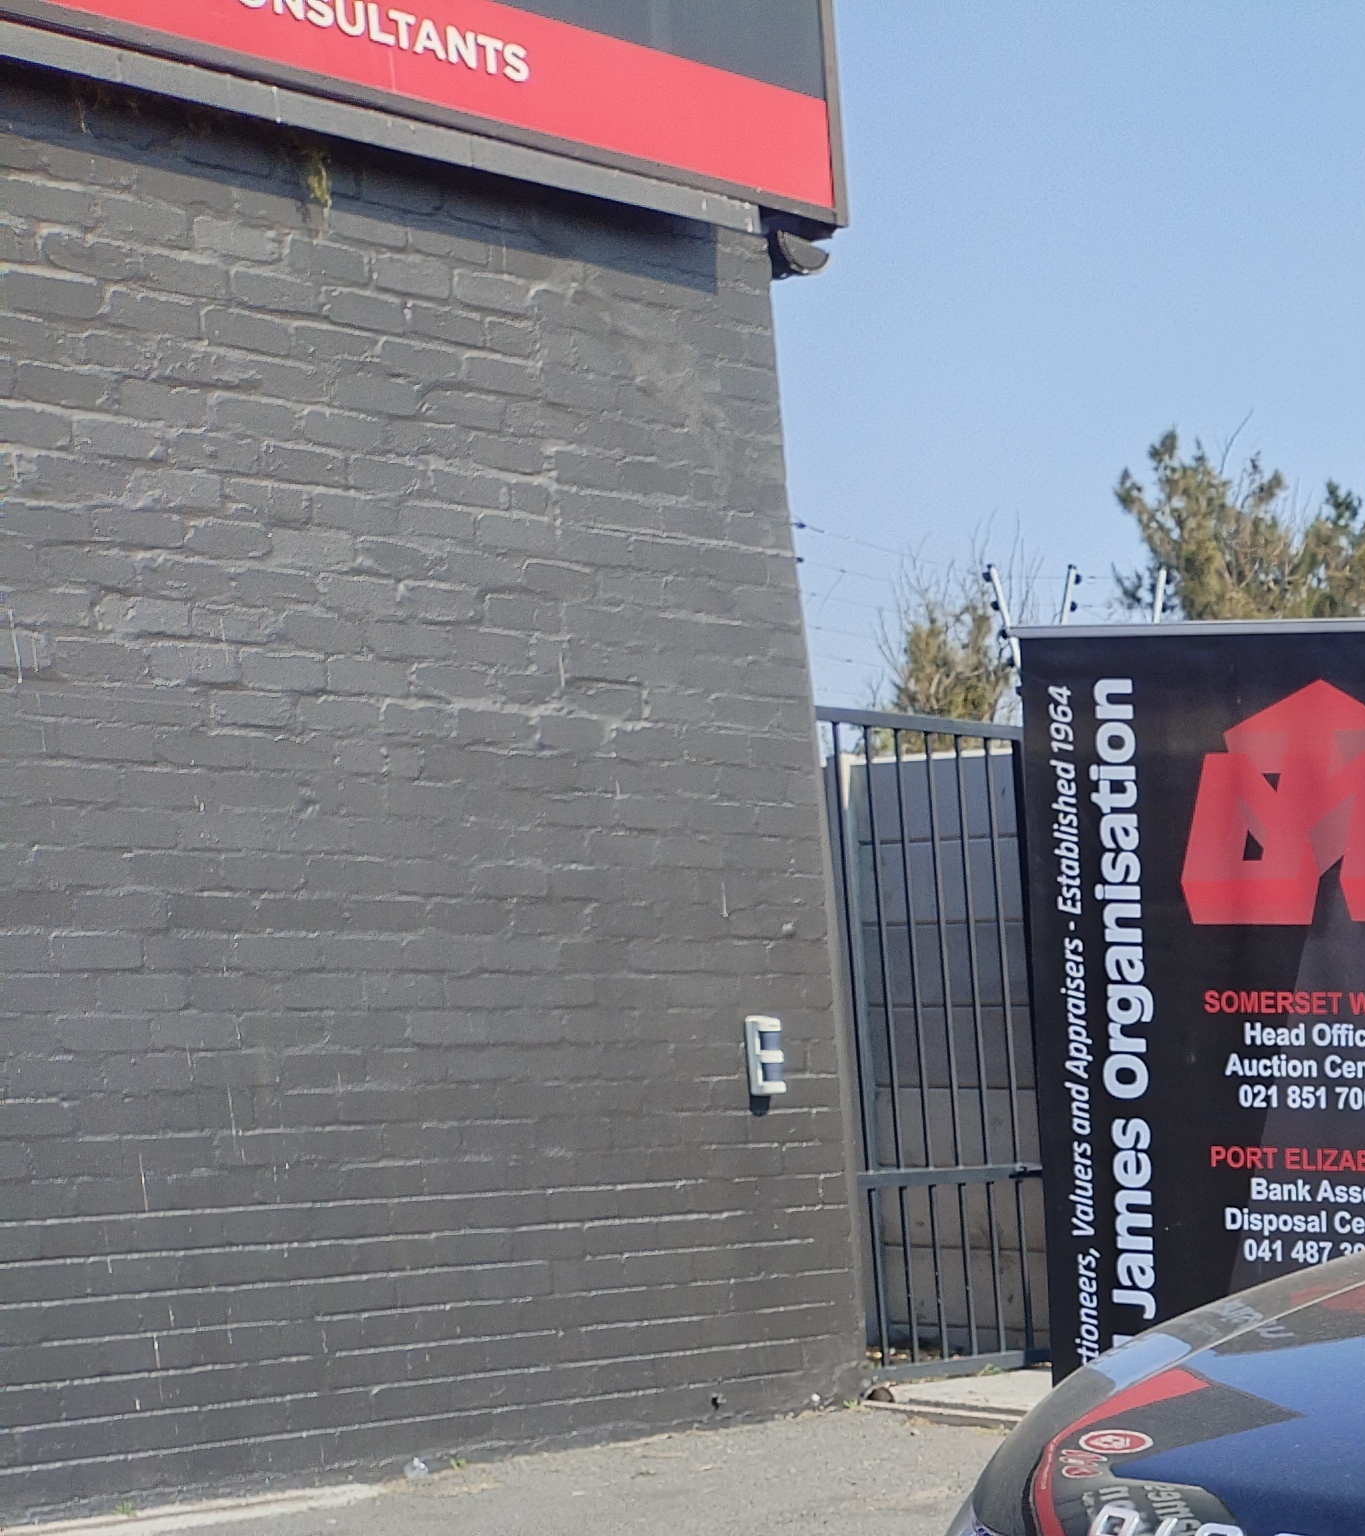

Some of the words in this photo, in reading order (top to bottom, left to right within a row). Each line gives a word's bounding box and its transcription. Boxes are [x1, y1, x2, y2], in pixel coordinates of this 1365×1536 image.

[239, 0, 530, 82] NSULTANTS
[1047, 685, 1075, 752] 1964
[1049, 759, 1083, 915] Established
[1089, 678, 1154, 1100] Organisation
[1059, 937, 1093, 1079] Appraisers
[1204, 990, 1342, 1014] SOMERSET
[1243, 1022, 1305, 1046] Head
[1225, 1053, 1318, 1079] Auction
[1064, 1082, 1091, 1135] and
[1238, 1084, 1278, 1108] 021
[1286, 1086, 1327, 1109] 851
[1210, 1146, 1278, 1169] PORT
[1068, 1141, 1095, 1236] Valuers
[1250, 1177, 1311, 1202] Bank
[1111, 1117, 1156, 1320] James
[1224, 1207, 1327, 1235] Disposal
[1243, 1239, 1283, 1263] 041
[1290, 1240, 1333, 1265] 487
